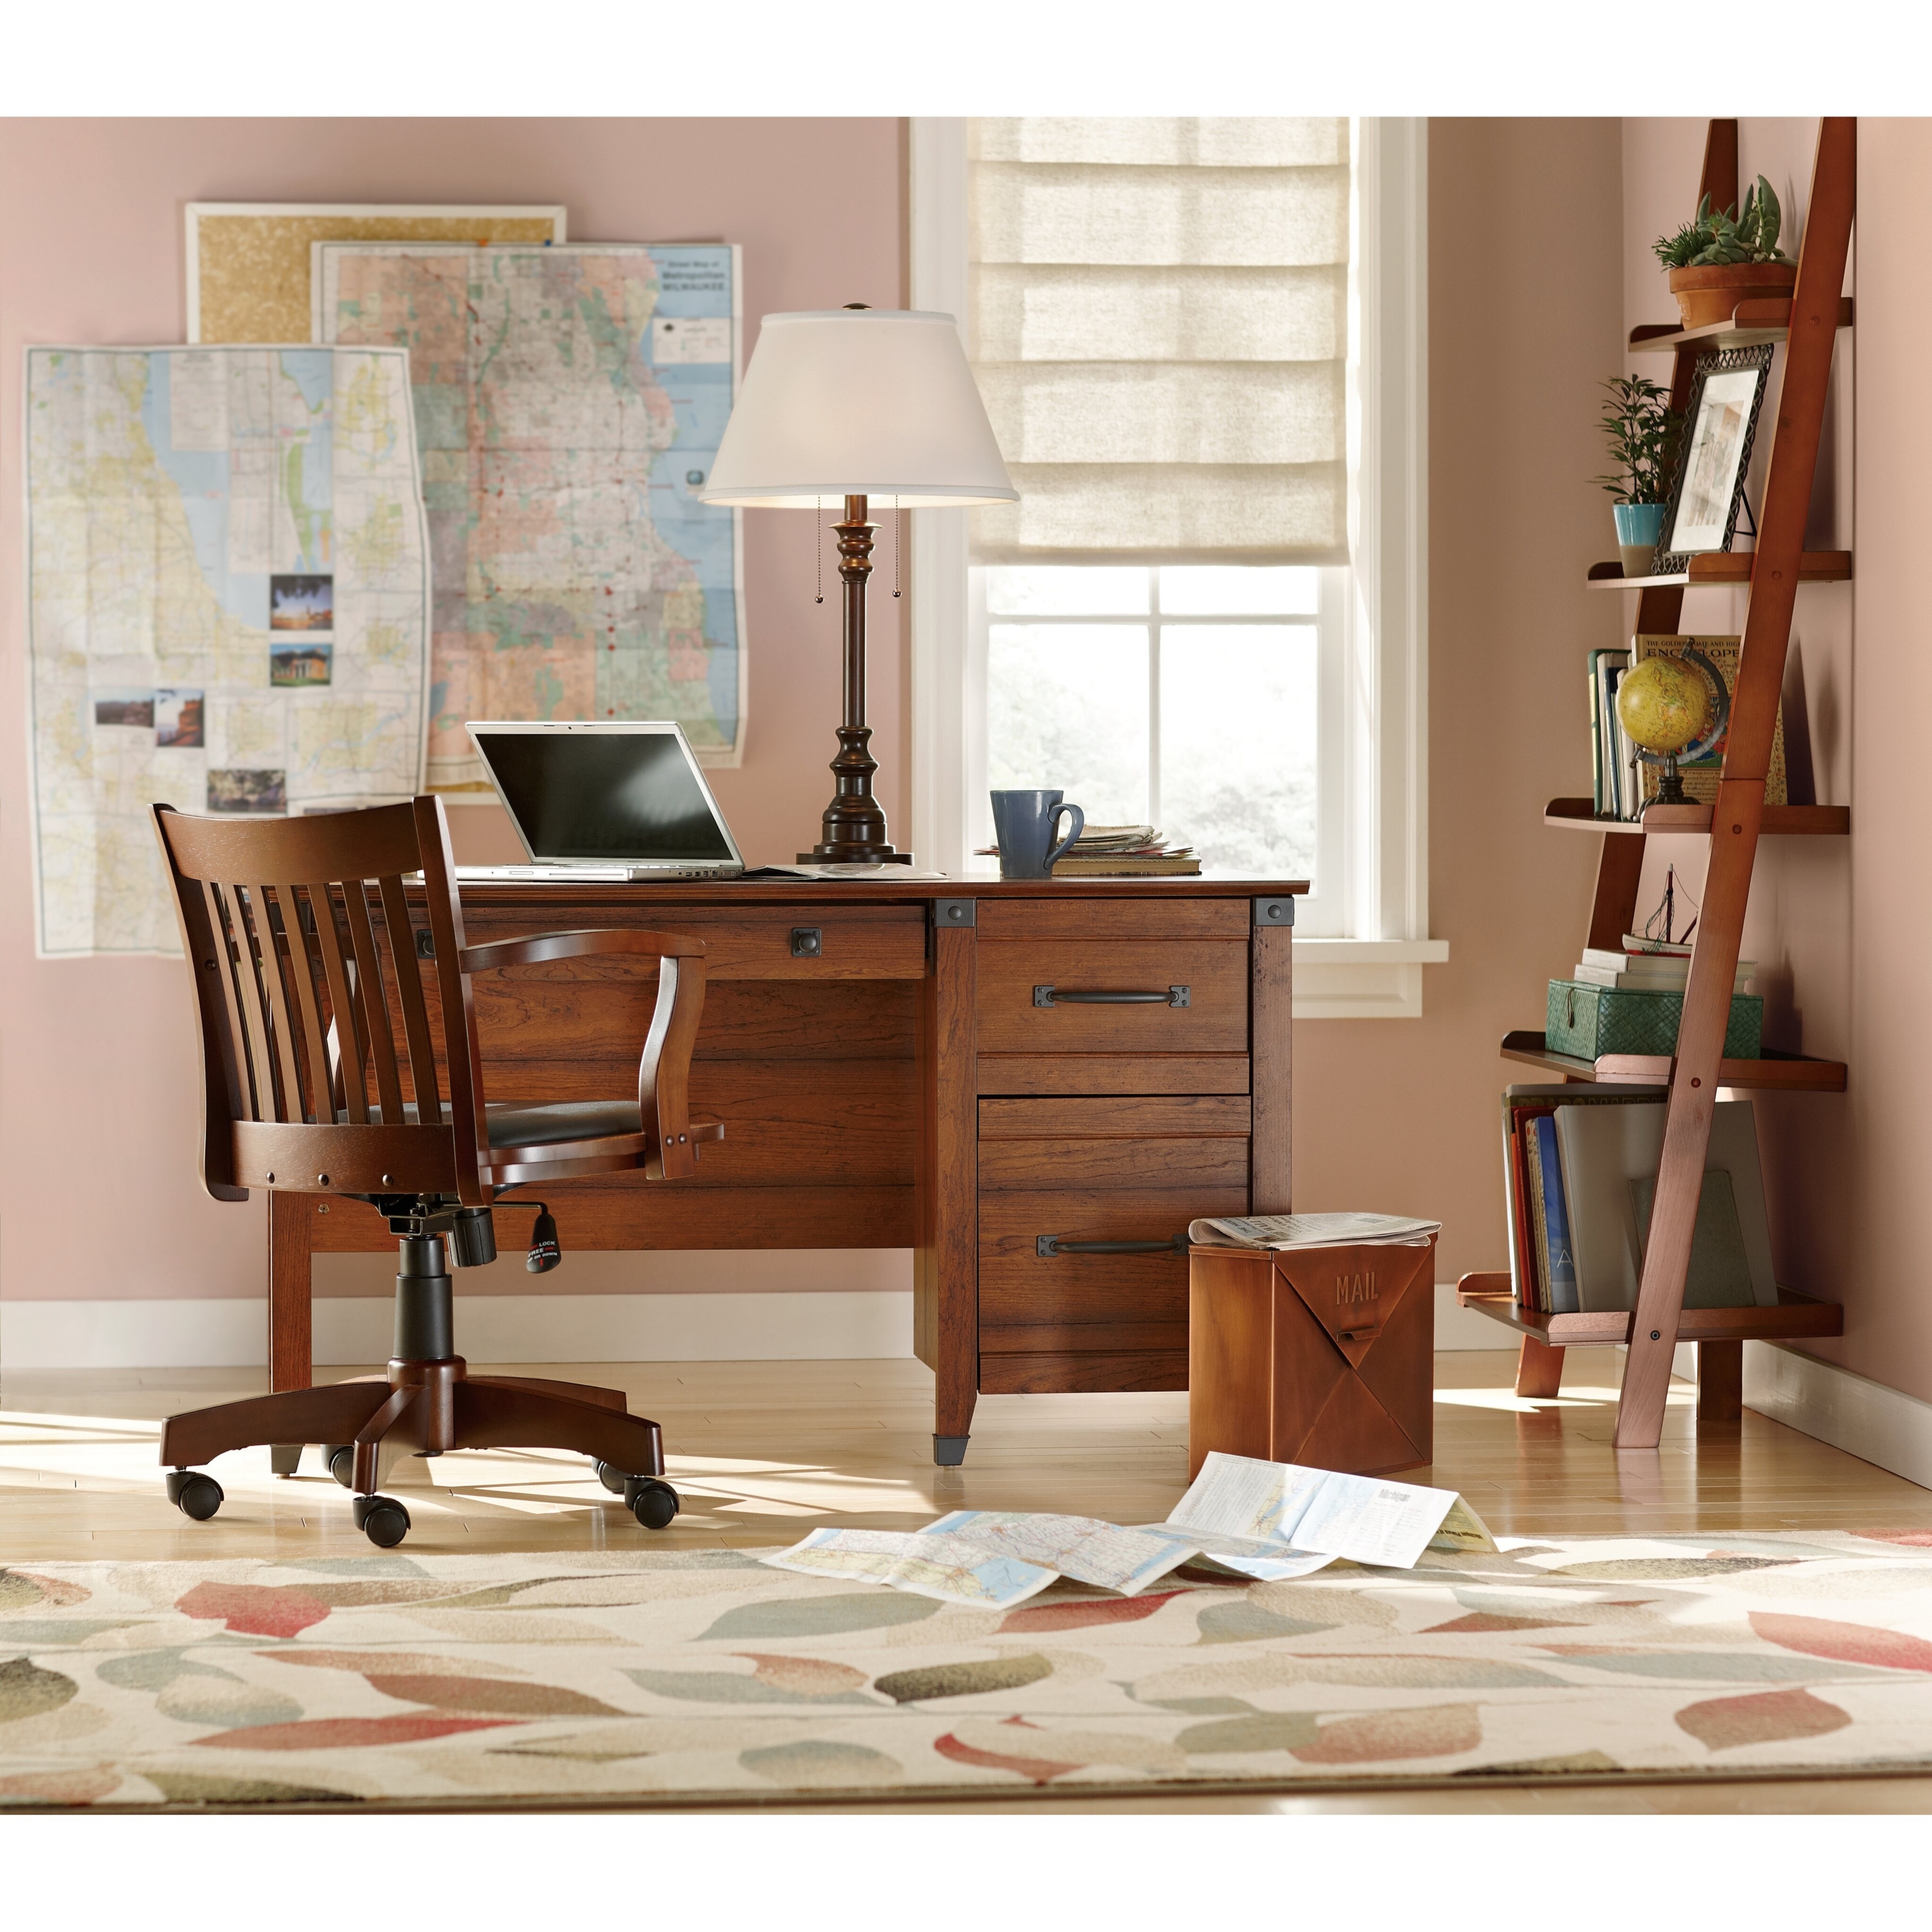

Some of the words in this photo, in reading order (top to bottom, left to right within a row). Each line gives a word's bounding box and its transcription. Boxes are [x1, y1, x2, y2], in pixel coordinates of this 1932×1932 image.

[663, 272, 724, 280] Metropolitan
[663, 282, 724, 291] MILWAUKEE
[528, 1247, 544, 1258] FREE
[1337, 1271, 1379, 1305] MAIL
